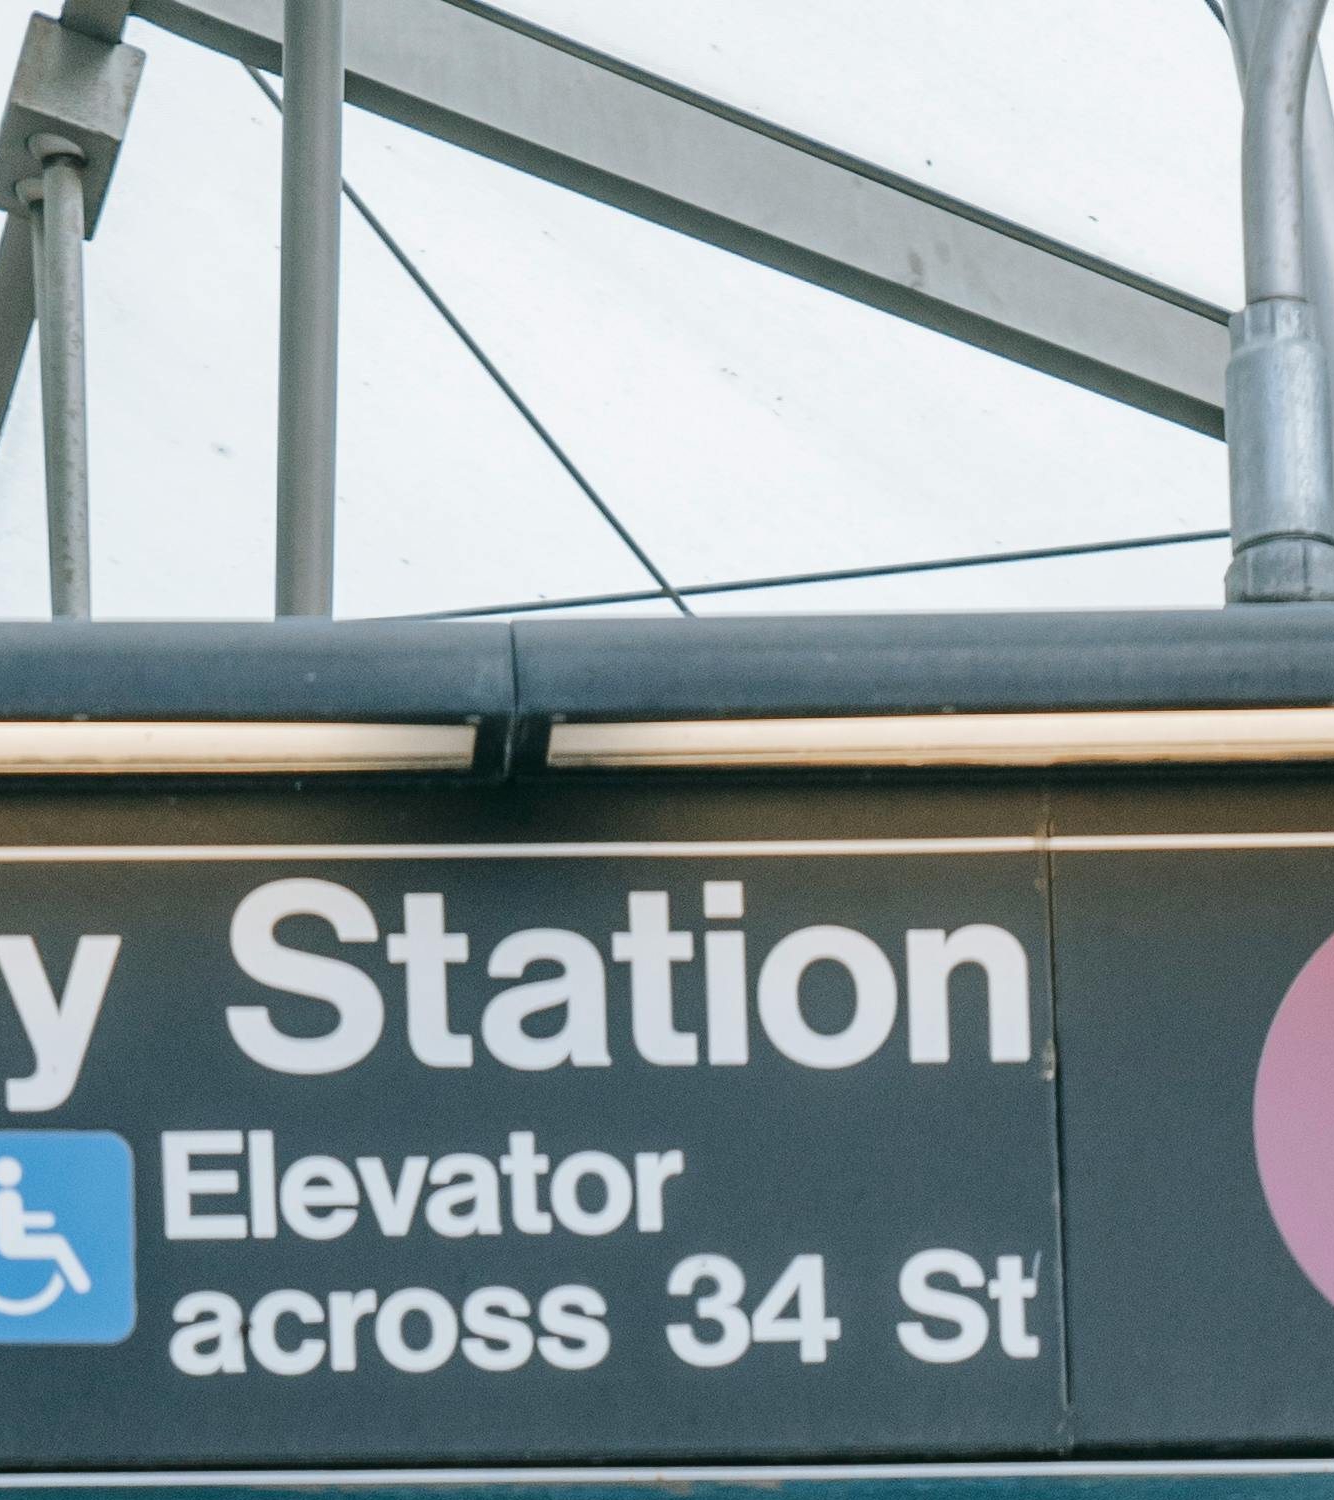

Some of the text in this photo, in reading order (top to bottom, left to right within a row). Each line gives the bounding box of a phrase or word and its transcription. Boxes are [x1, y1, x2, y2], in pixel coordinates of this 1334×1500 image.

[227, 878, 1030, 1074] Station
[162, 1130, 683, 1239] Elevator
[170, 1249, 1039, 1375] across 34 St
